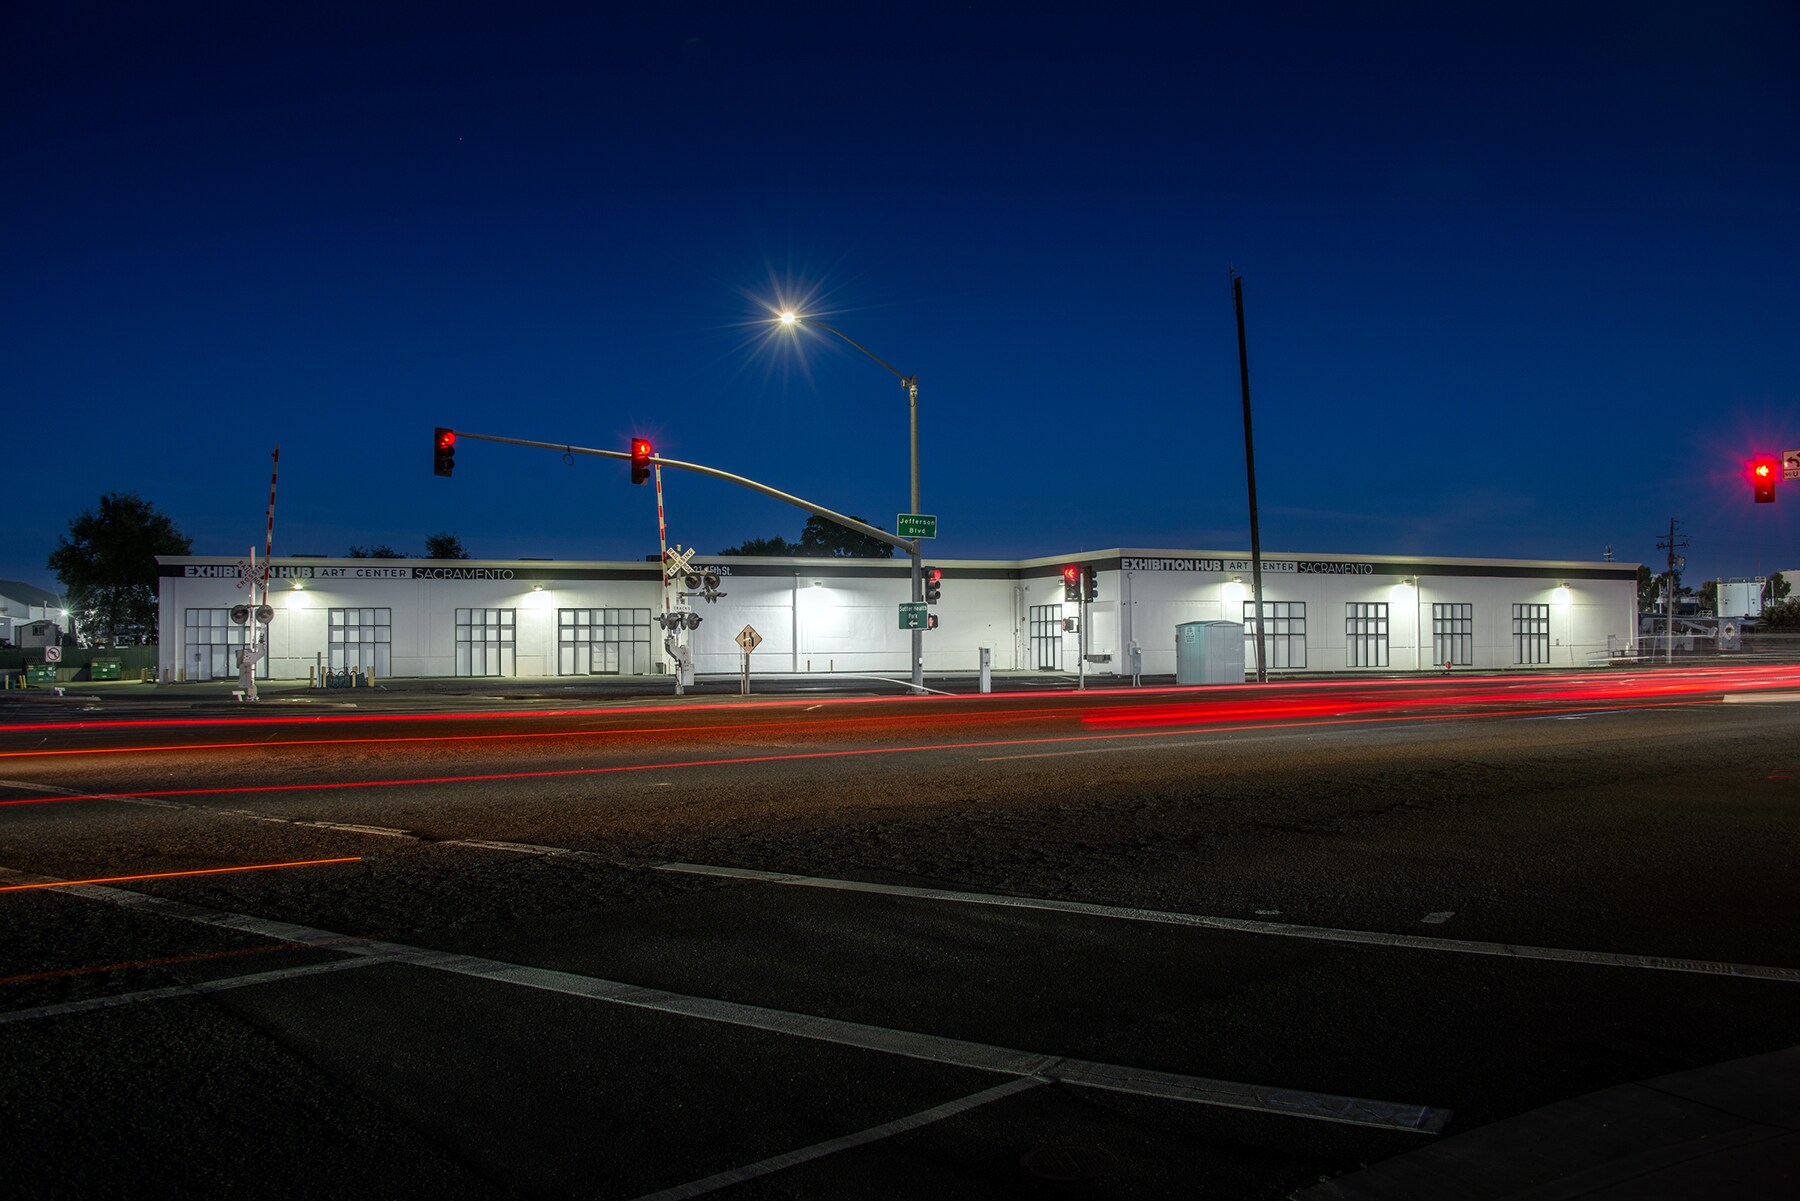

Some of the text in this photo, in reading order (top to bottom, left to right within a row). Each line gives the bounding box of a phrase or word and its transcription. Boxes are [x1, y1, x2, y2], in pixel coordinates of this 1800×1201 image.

[900, 518, 935, 526] Jefferson
[279, 566, 312, 578] HUB
[322, 568, 346, 577] ART
[356, 568, 406, 577] CENTER
[416, 568, 514, 580] SACRAMENTO
[1121, 558, 1193, 570] EXHIBITION
[1196, 560, 1221, 571] HUB
[1230, 562, 1248, 570] ART
[1300, 562, 1372, 575] SACRAMENTO
